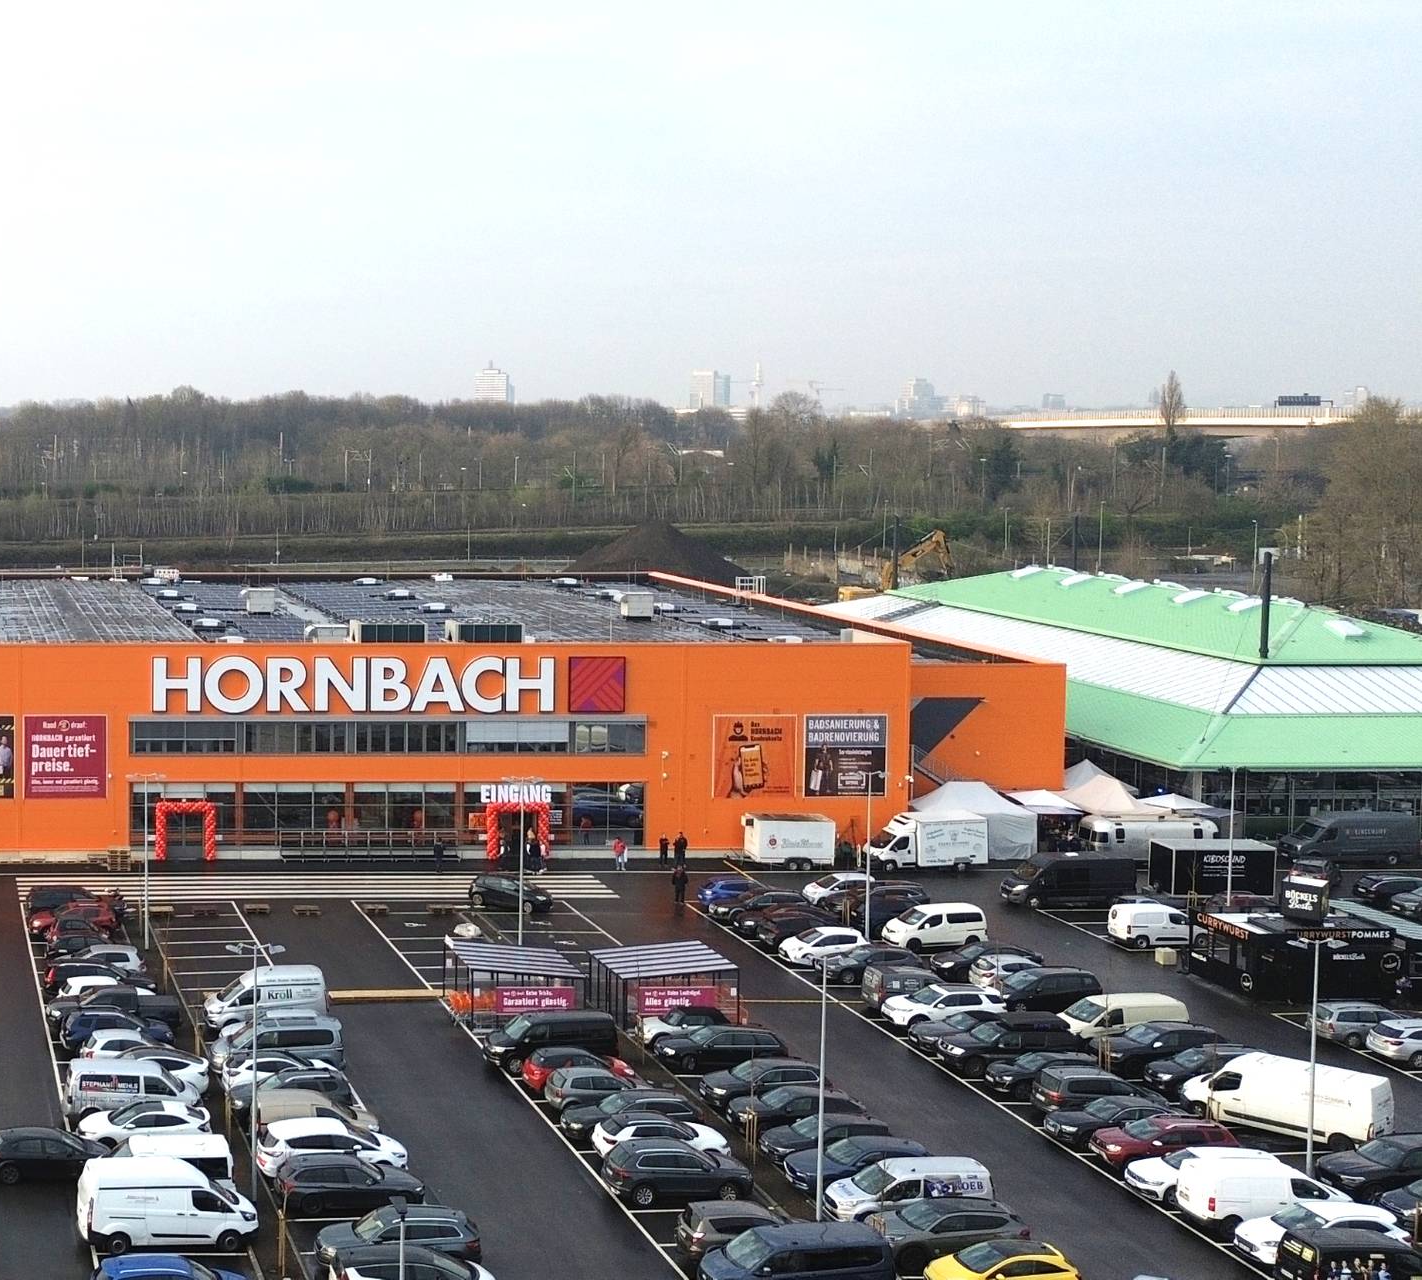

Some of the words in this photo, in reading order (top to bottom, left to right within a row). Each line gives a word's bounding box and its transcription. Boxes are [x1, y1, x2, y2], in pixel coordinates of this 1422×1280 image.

[151, 655, 556, 714] HORNBACH
[808, 719, 871, 730] BADSANIERUNG
[873, 720, 880, 729] &
[64, 733, 96, 743] garantiert
[808, 731, 880, 742] BADRENOVIERUNG
[31, 744, 96, 758] Dauertief-
[31, 758, 75, 775] preise.
[480, 784, 553, 803] EINGANG
[1284, 889, 1318, 903] BÖCKELS
[1196, 912, 1250, 941] CURRYWURST
[1297, 931, 1352, 939] URRYWURST
[1351, 930, 1391, 939] POMMES
[267, 988, 293, 1000] Kroll
[503, 997, 539, 1006] Garantiert
[540, 996, 570, 1007] günstig.
[644, 997, 662, 1006] Alles
[663, 996, 693, 1008] günstig.
